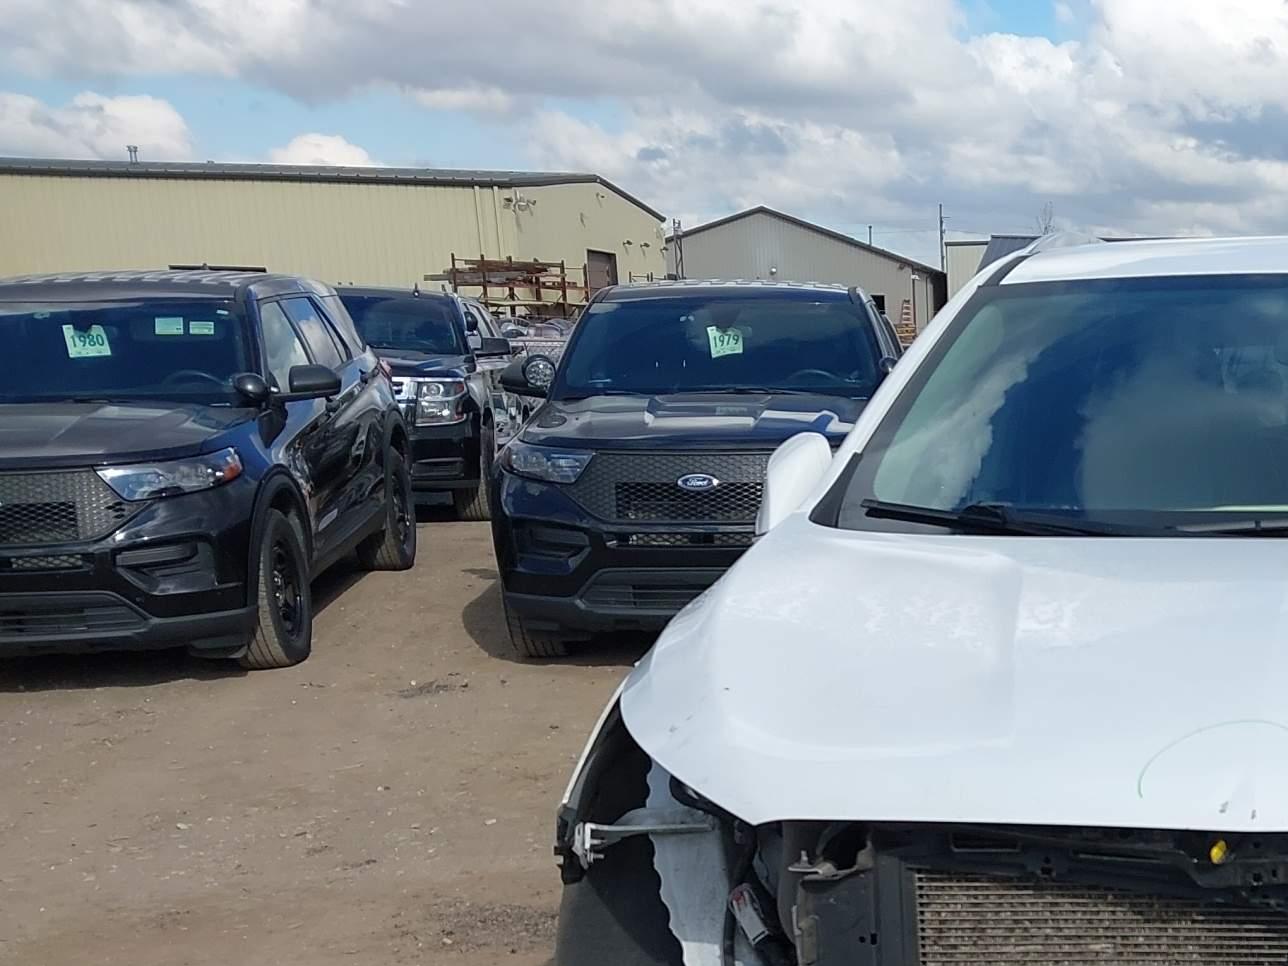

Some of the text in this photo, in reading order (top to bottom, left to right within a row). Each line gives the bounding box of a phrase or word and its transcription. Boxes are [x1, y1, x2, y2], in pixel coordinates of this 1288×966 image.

[70, 334, 105, 348] 1980
[713, 333, 740, 348] 1979
[687, 477, 709, 487] Ford
